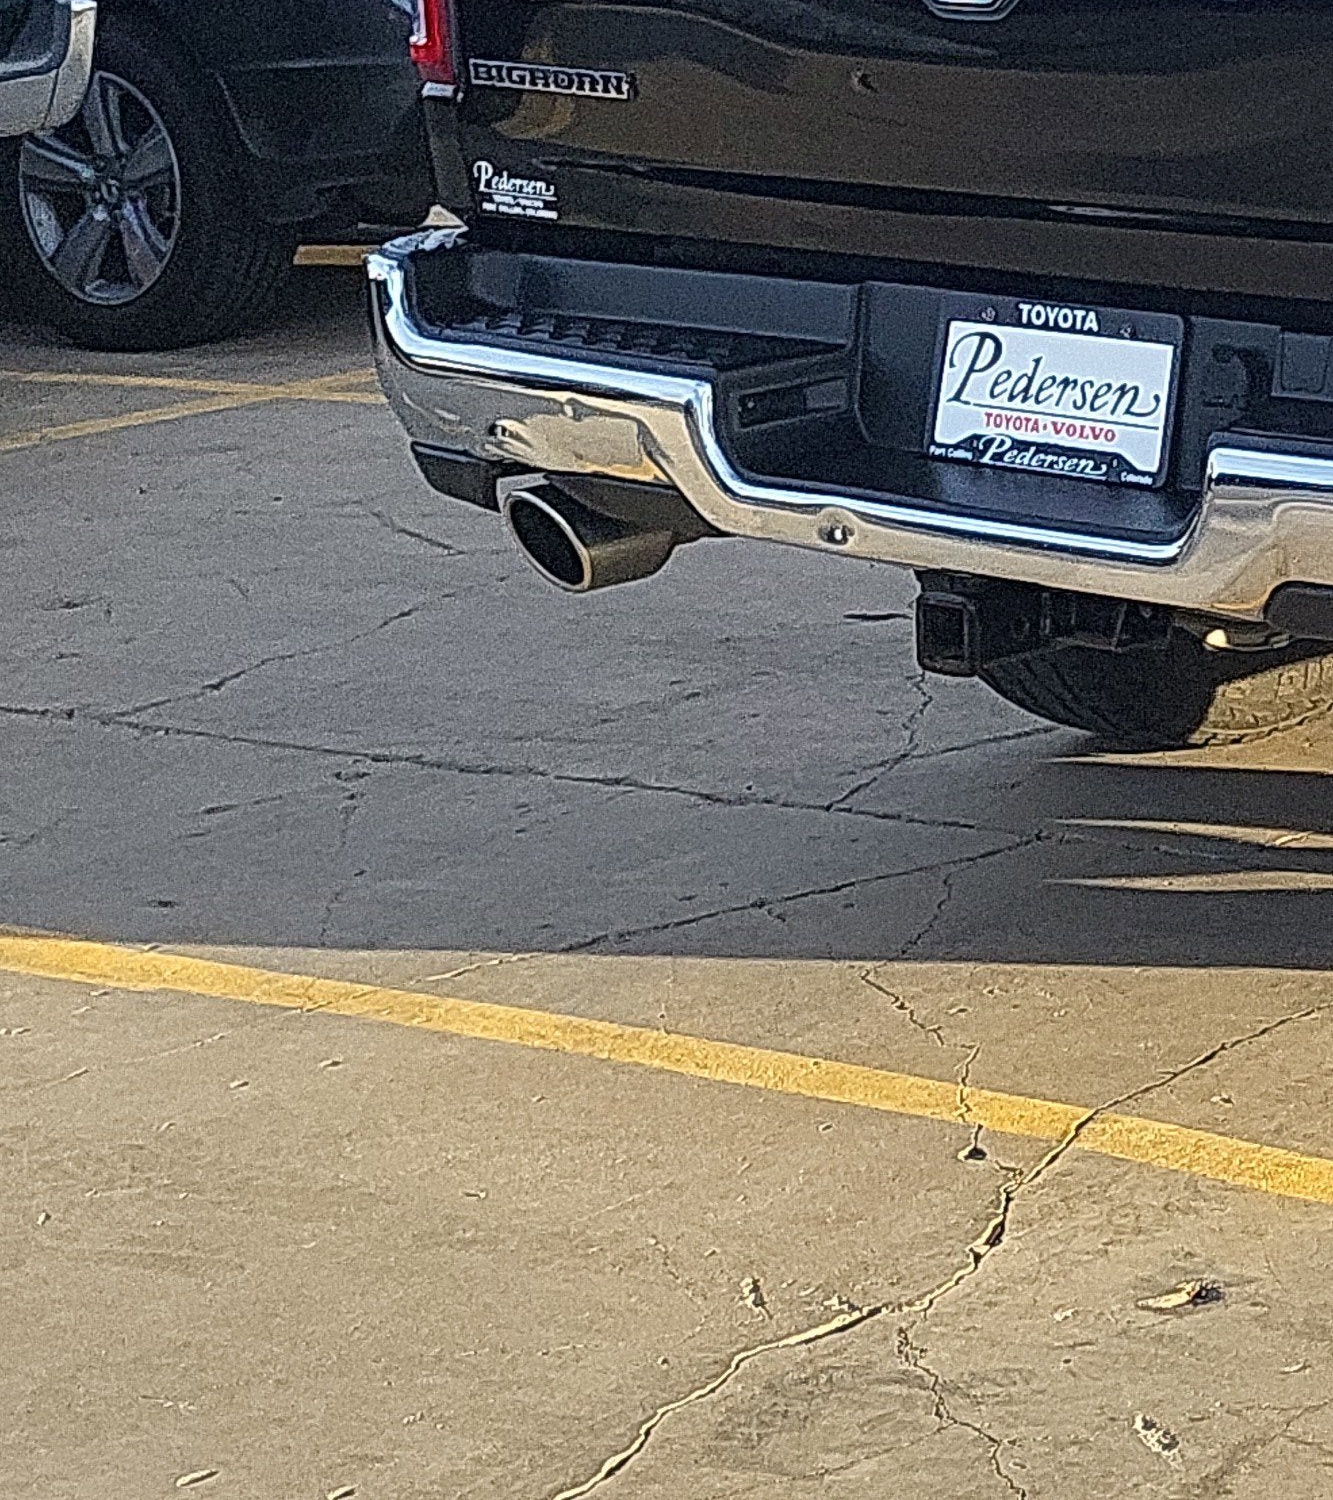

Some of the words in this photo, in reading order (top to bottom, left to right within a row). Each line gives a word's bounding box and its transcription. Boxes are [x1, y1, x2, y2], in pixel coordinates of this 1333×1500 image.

[473, 160, 555, 195] Pedersen
[1018, 303, 1099, 332] TOYOTA
[946, 331, 1161, 418] Pedersen
[984, 412, 1040, 434] TOYOTA
[1051, 420, 1117, 443] VOLVO
[978, 434, 1108, 476] Pedersen
